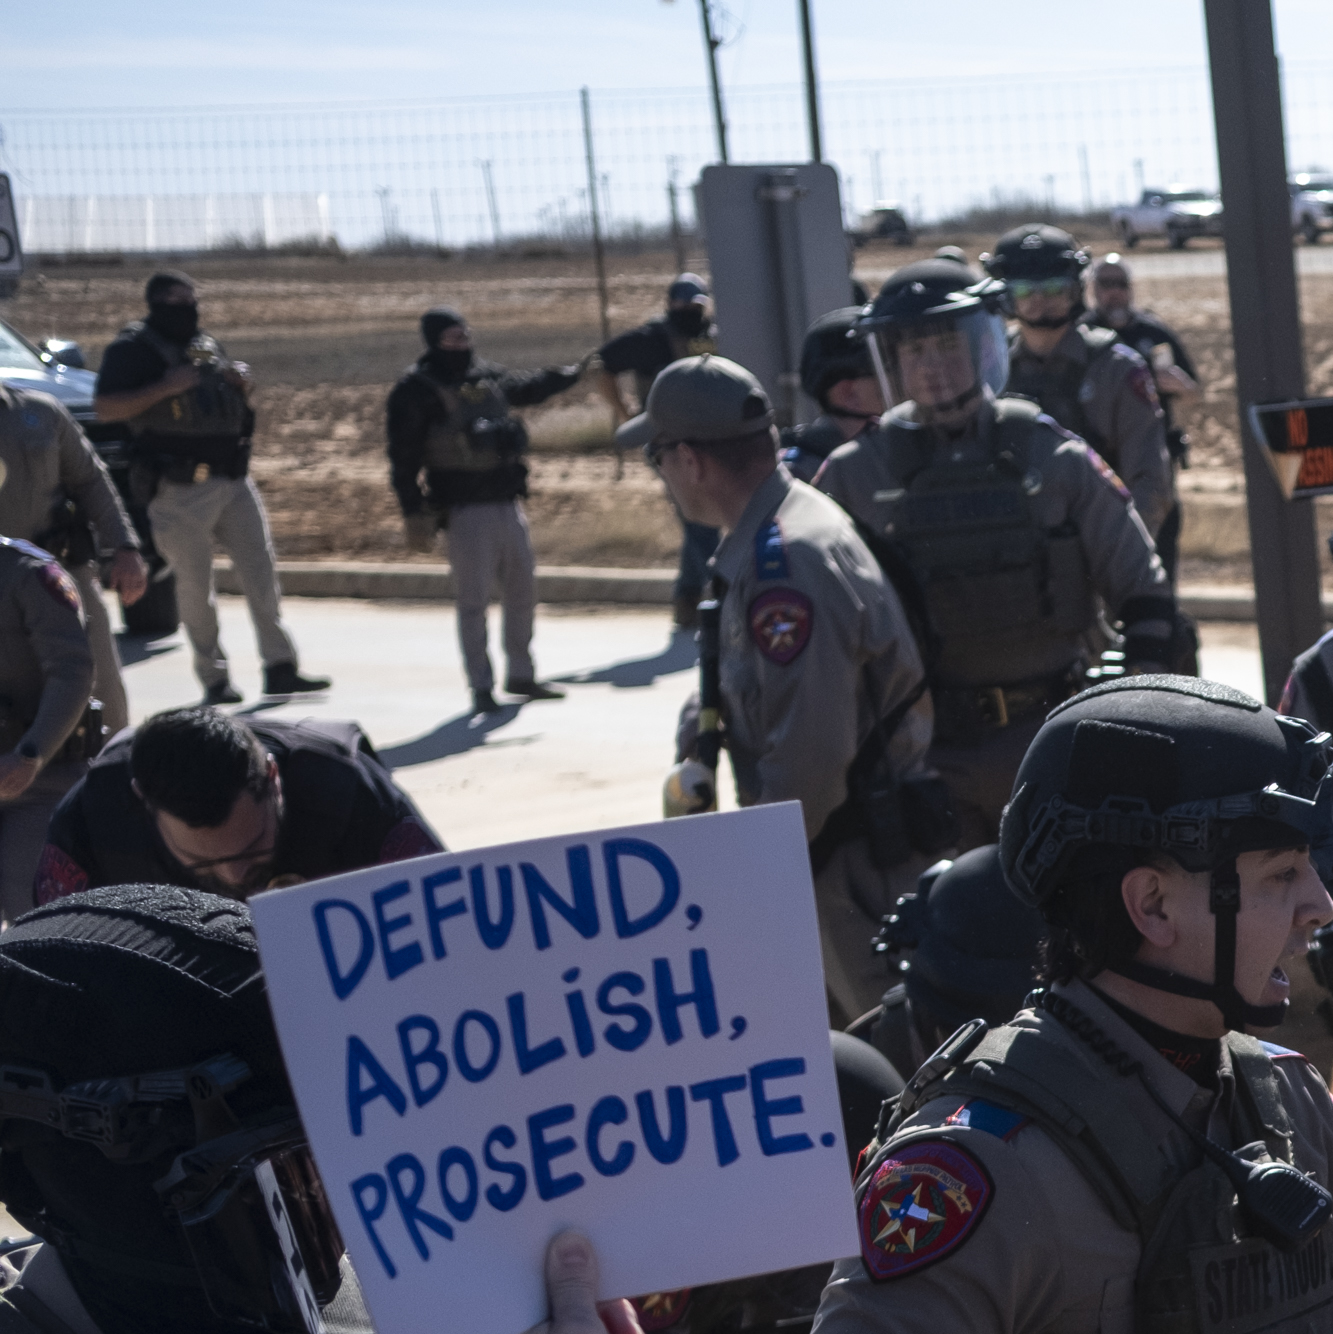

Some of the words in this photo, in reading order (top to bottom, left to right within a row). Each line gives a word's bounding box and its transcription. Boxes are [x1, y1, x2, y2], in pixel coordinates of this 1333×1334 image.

[1287, 408, 1309, 447] NO
[310, 837, 705, 1003] DEFUND,
[347, 1056, 838, 1281] PROSECUTE.
[1204, 1249, 1273, 1325] STATE
